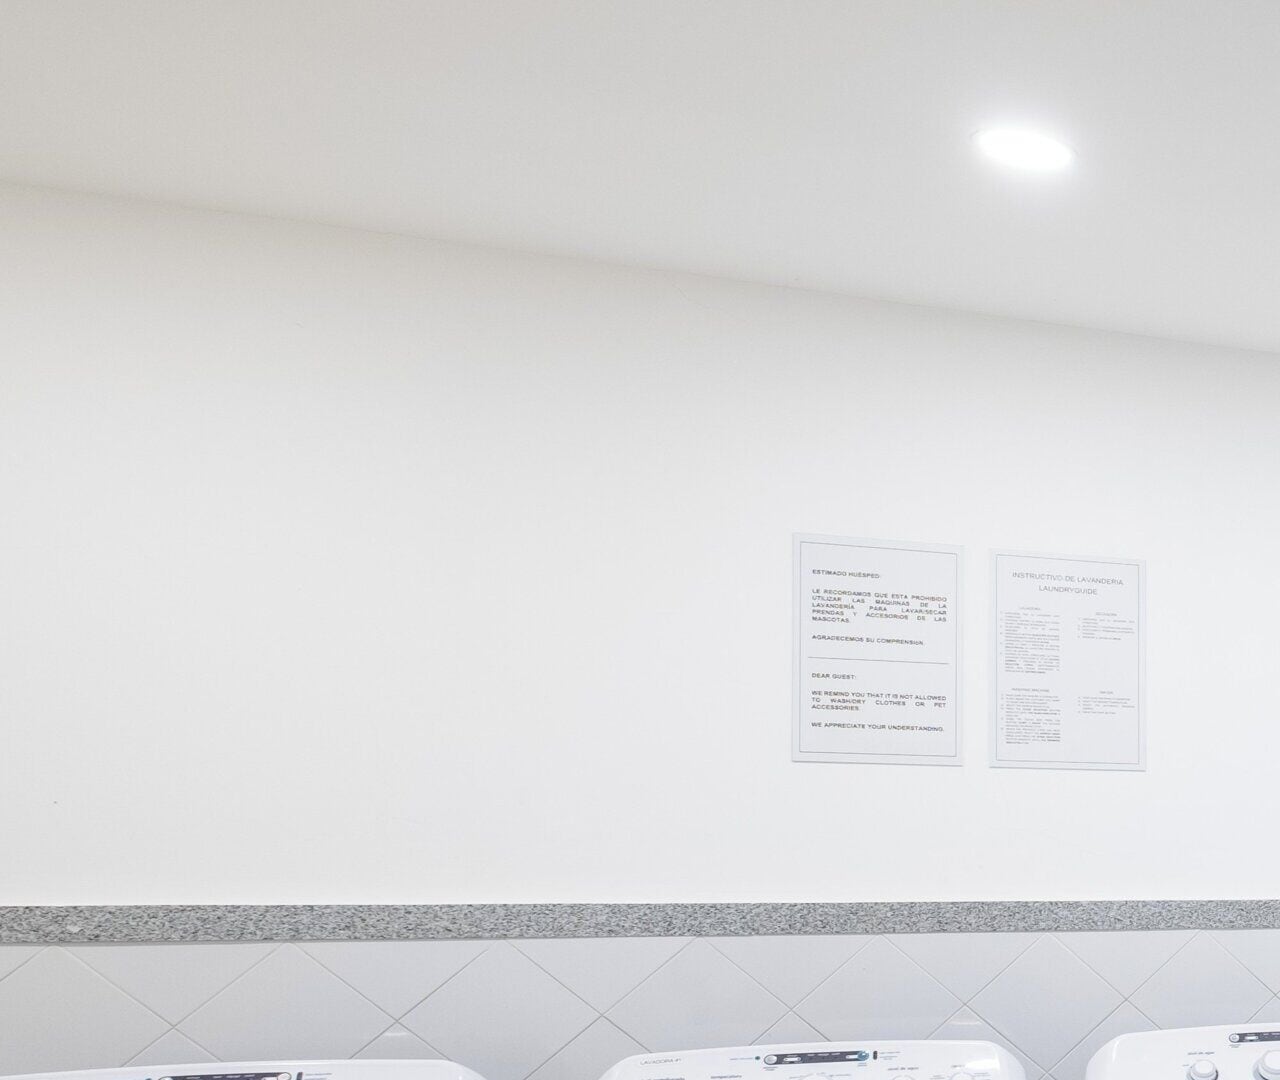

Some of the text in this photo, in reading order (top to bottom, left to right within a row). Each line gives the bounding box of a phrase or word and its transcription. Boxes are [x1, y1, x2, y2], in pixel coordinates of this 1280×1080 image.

[1012, 572, 1062, 581] INSTRUCTIVO
[823, 589, 871, 597] RECORDAMOS
[811, 634, 863, 642] AGRADECEMOS
